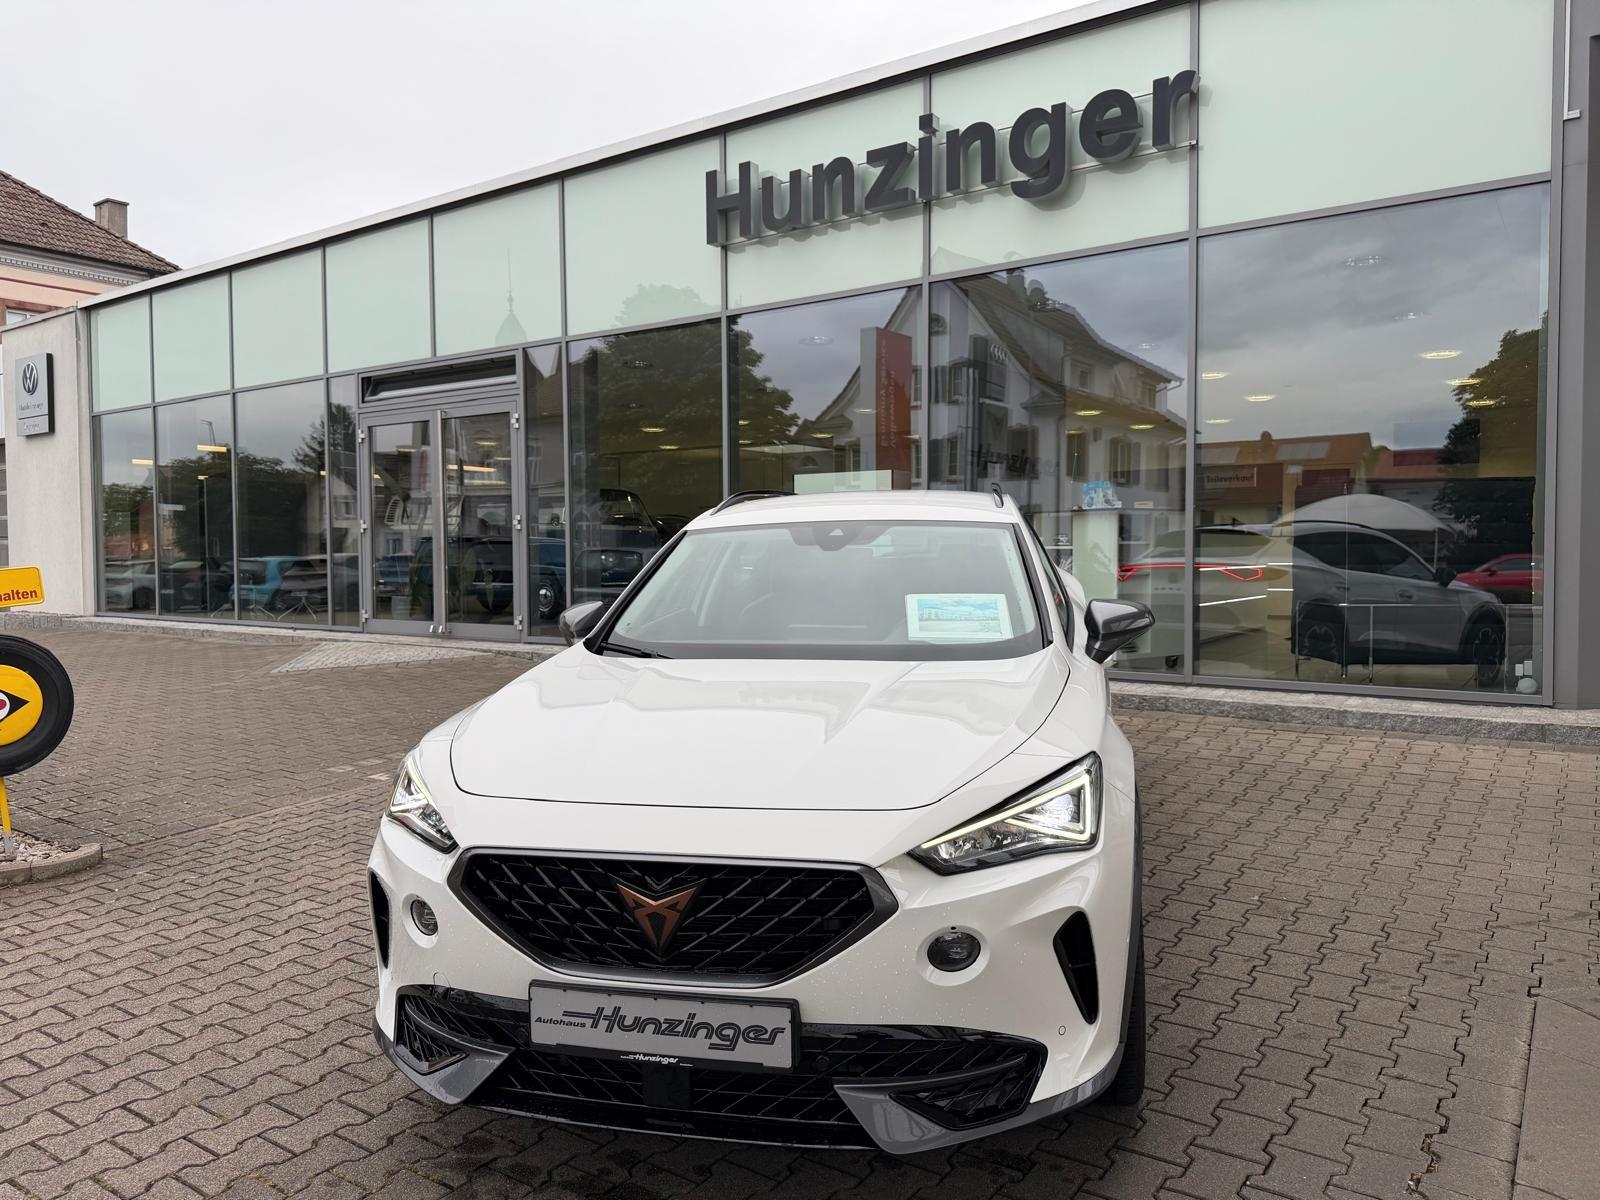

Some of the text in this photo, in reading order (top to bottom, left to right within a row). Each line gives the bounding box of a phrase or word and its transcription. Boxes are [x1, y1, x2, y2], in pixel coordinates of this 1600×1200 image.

[705, 69, 1199, 246] Hunzinger
[534, 1006, 786, 1051] Autohaus Hunzinger
[629, 1053, 678, 1064] Hunzinger
